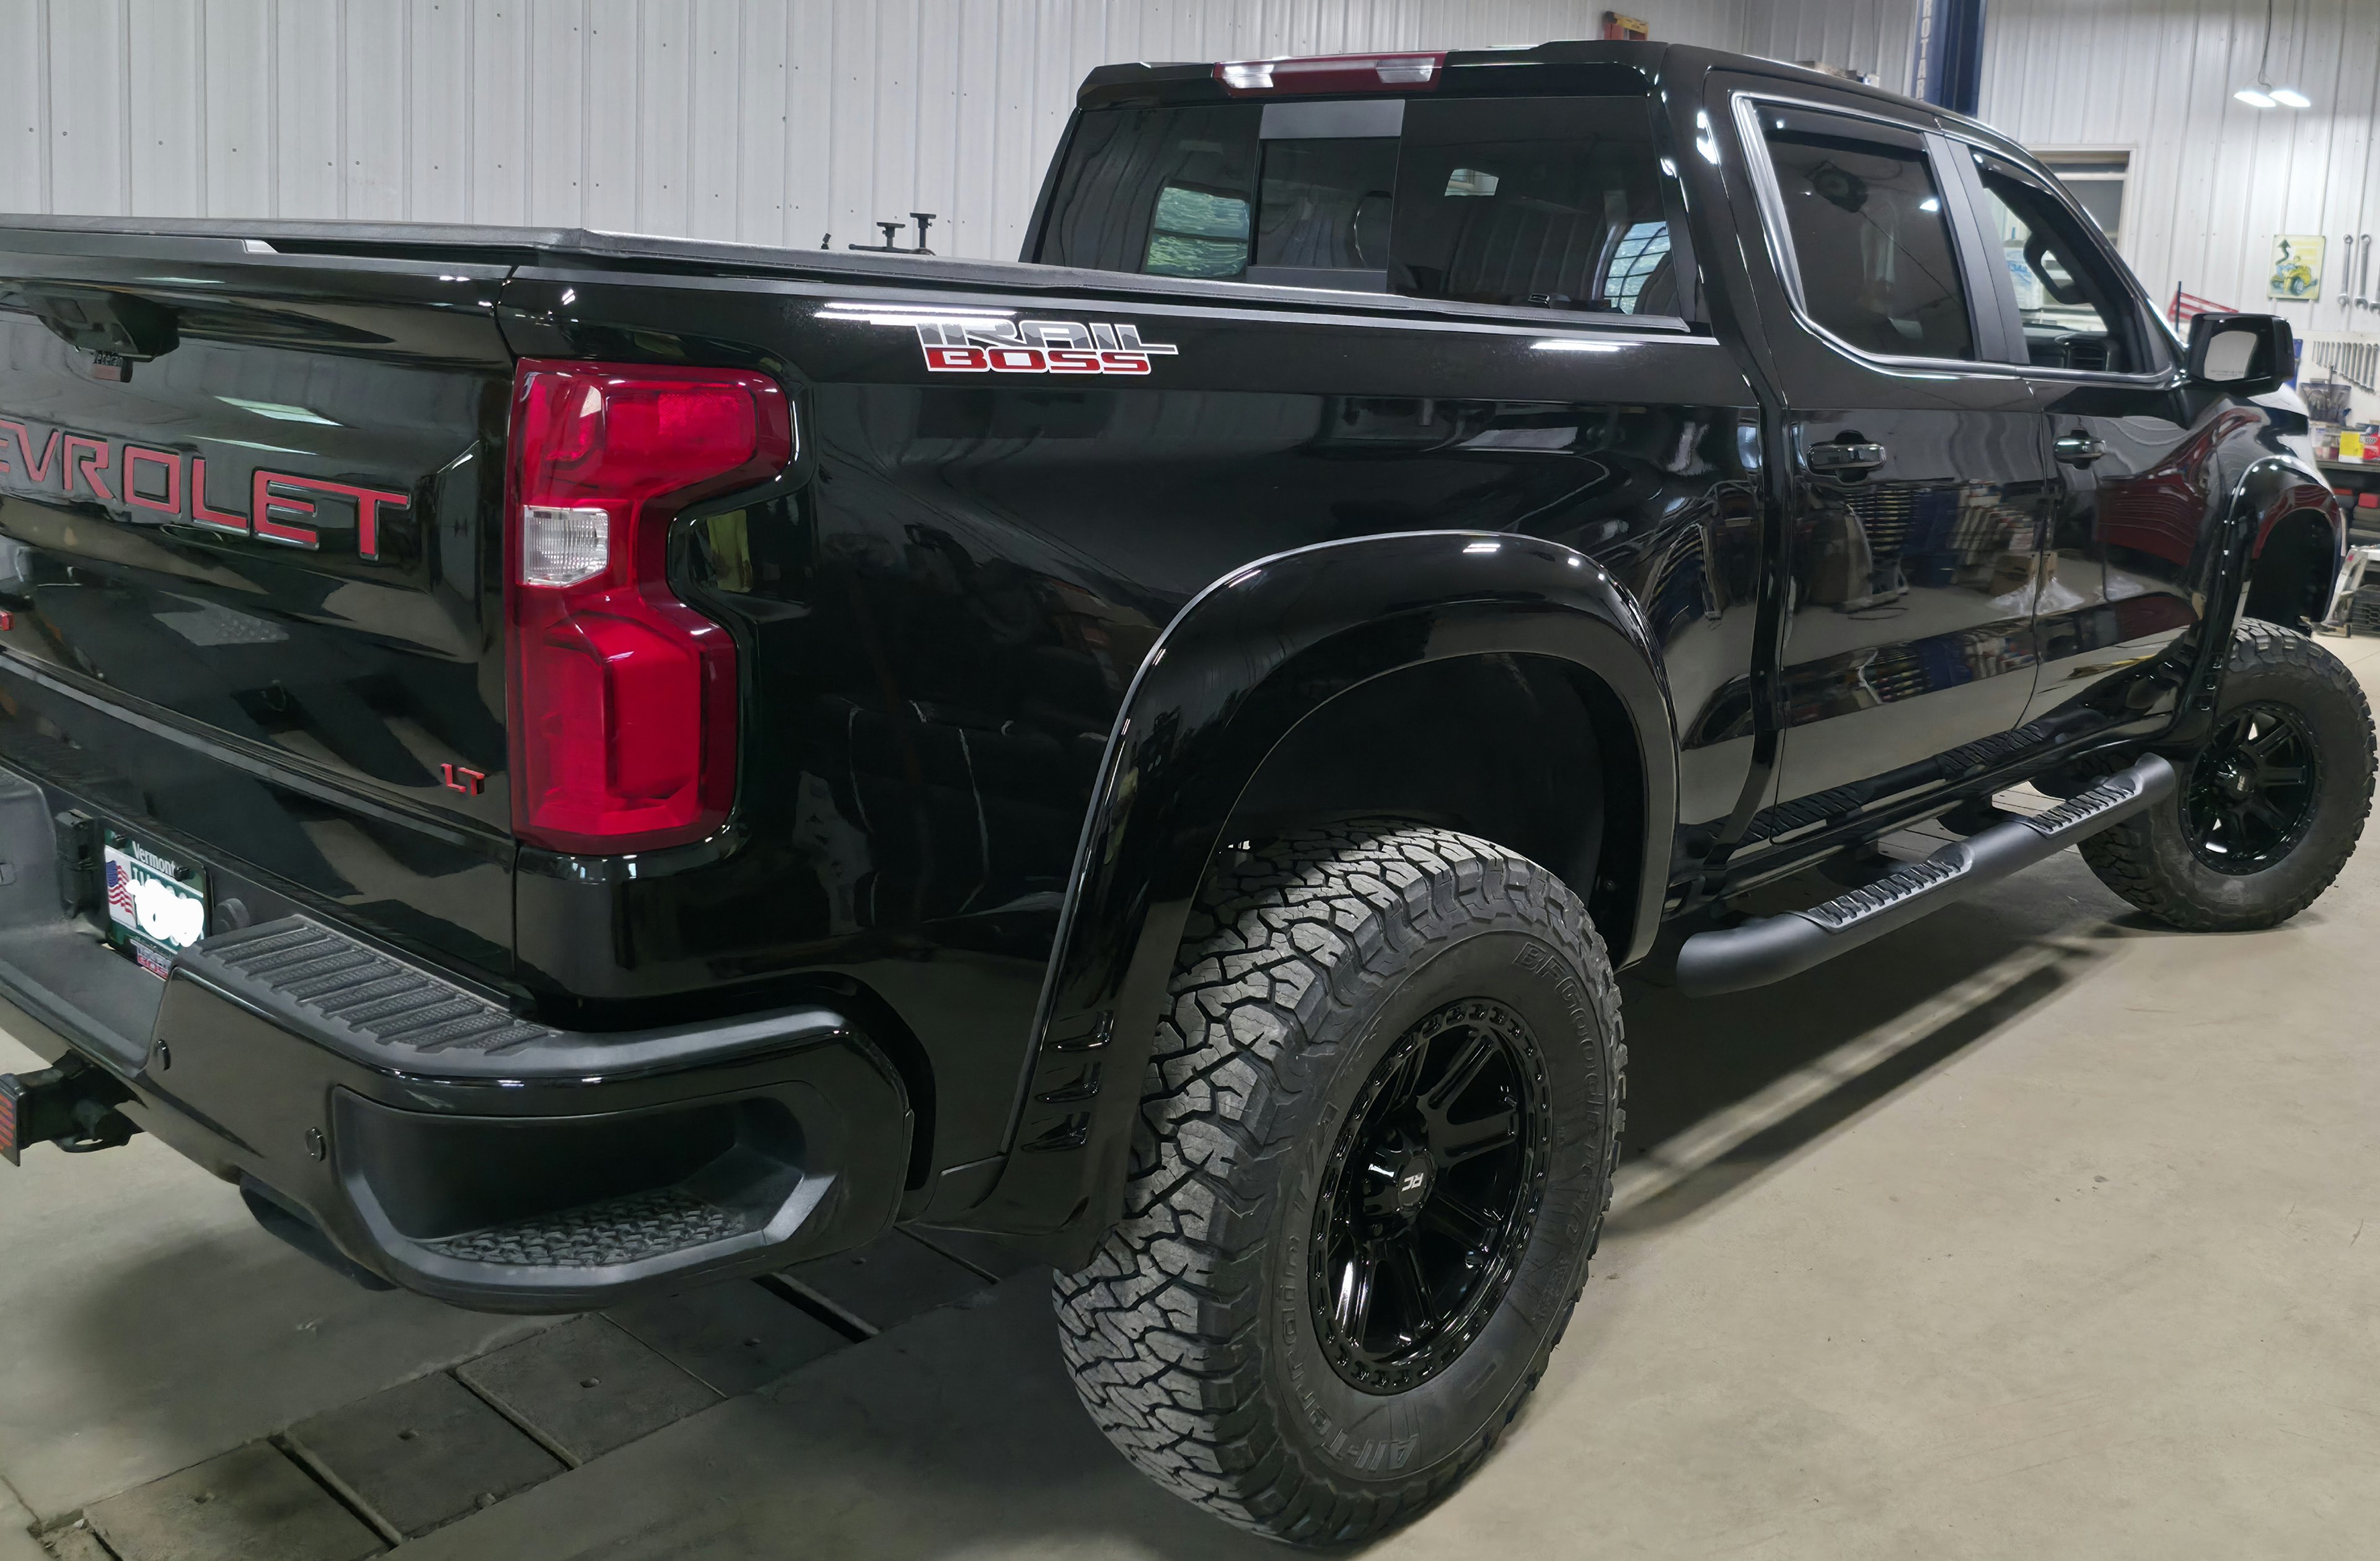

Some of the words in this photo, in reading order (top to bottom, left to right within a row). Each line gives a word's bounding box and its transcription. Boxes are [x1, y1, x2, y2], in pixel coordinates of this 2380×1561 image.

[1916, 0, 1932, 102] ROTAR
[923, 346, 1151, 375] BOSS
[0, 419, 410, 559] VROLET
[441, 763, 485, 797] LT
[132, 840, 176, 877] Vermont
[137, 953, 169, 980] BOS
[1401, 1172, 1424, 1192] RC
